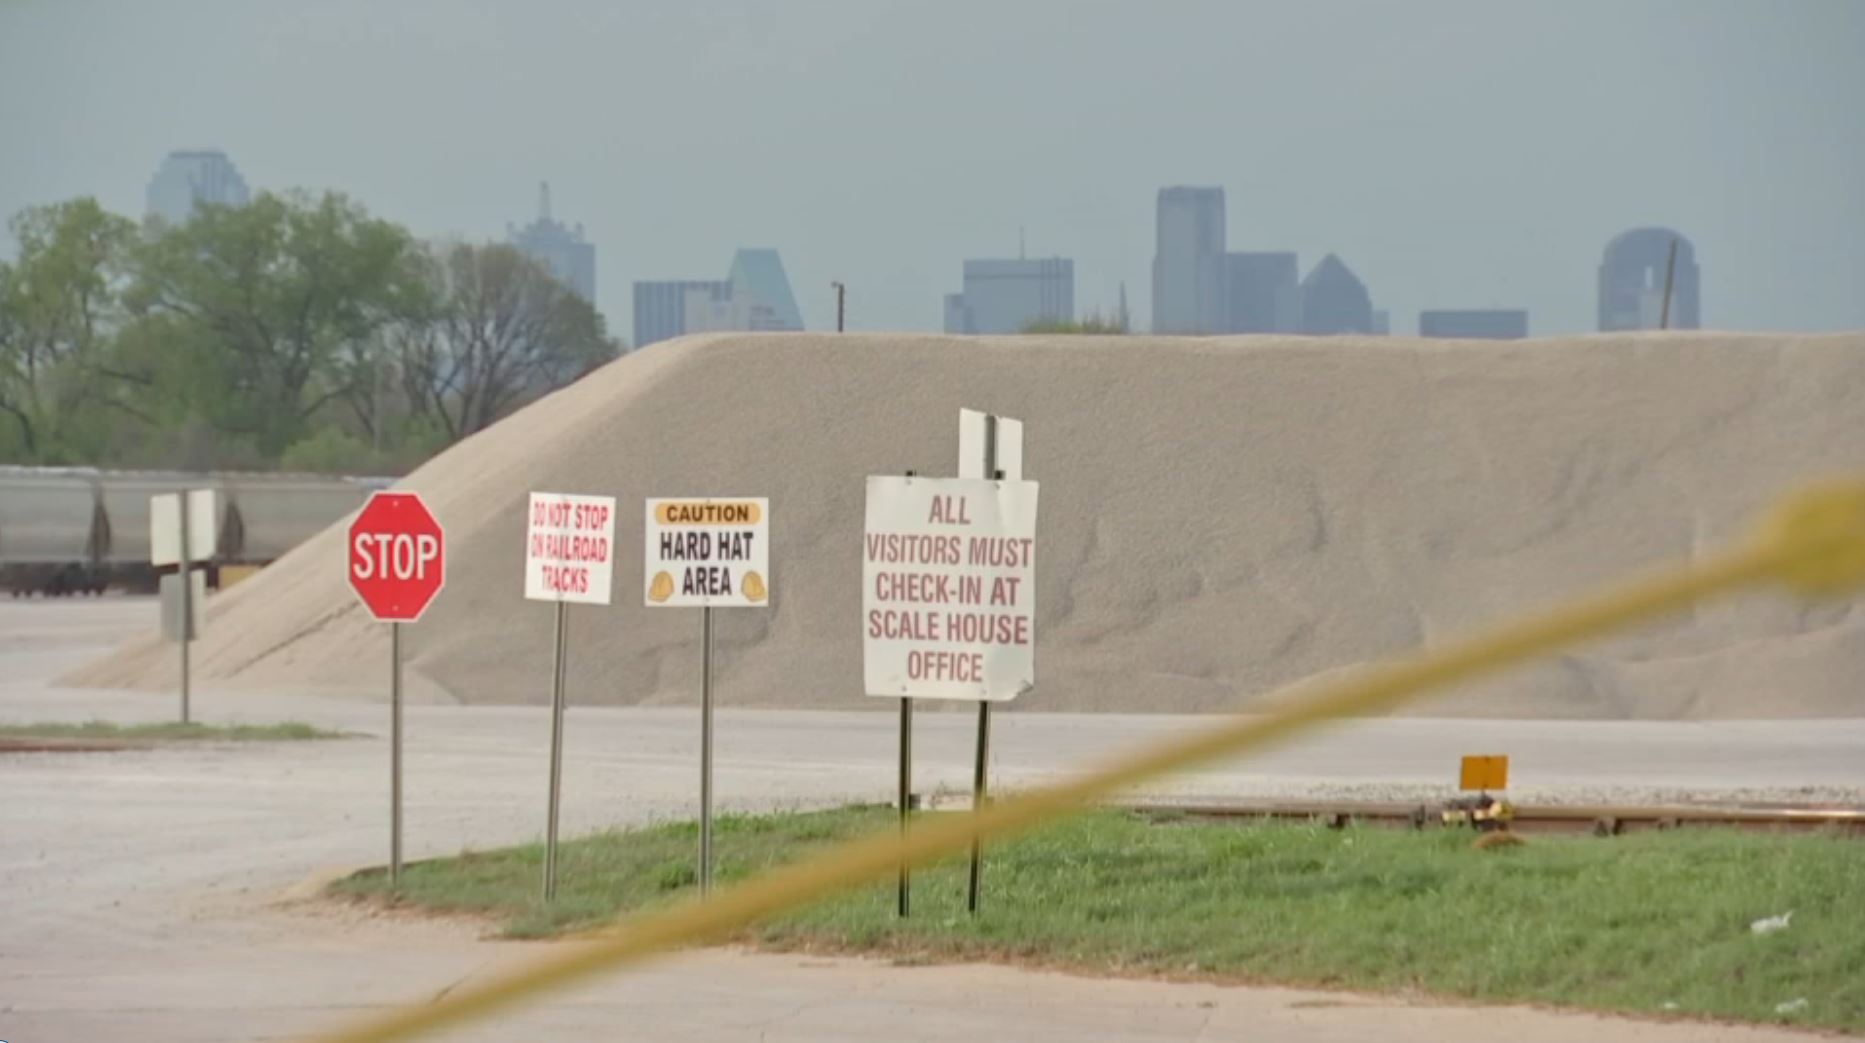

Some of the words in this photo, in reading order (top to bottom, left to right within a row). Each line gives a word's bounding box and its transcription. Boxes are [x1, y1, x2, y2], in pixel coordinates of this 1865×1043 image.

[549, 503, 572, 529] NOT
[575, 504, 609, 531] STOP
[666, 505, 749, 522] CAUTION
[928, 495, 971, 525] ALL
[353, 532, 438, 580] STOP
[546, 534, 608, 563] RAILROAD
[660, 531, 711, 561] HARD
[718, 531, 754, 561] HAT
[866, 533, 961, 566] VISITORS
[968, 536, 1032, 568] MUST
[542, 565, 588, 594] TRACKS
[682, 566, 732, 596] AREA
[875, 571, 982, 605] CHECK-IN
[990, 576, 1021, 607] AT
[868, 609, 940, 641] SCALE
[946, 612, 1028, 645] HOUSE
[907, 650, 983, 683] OFFICE
